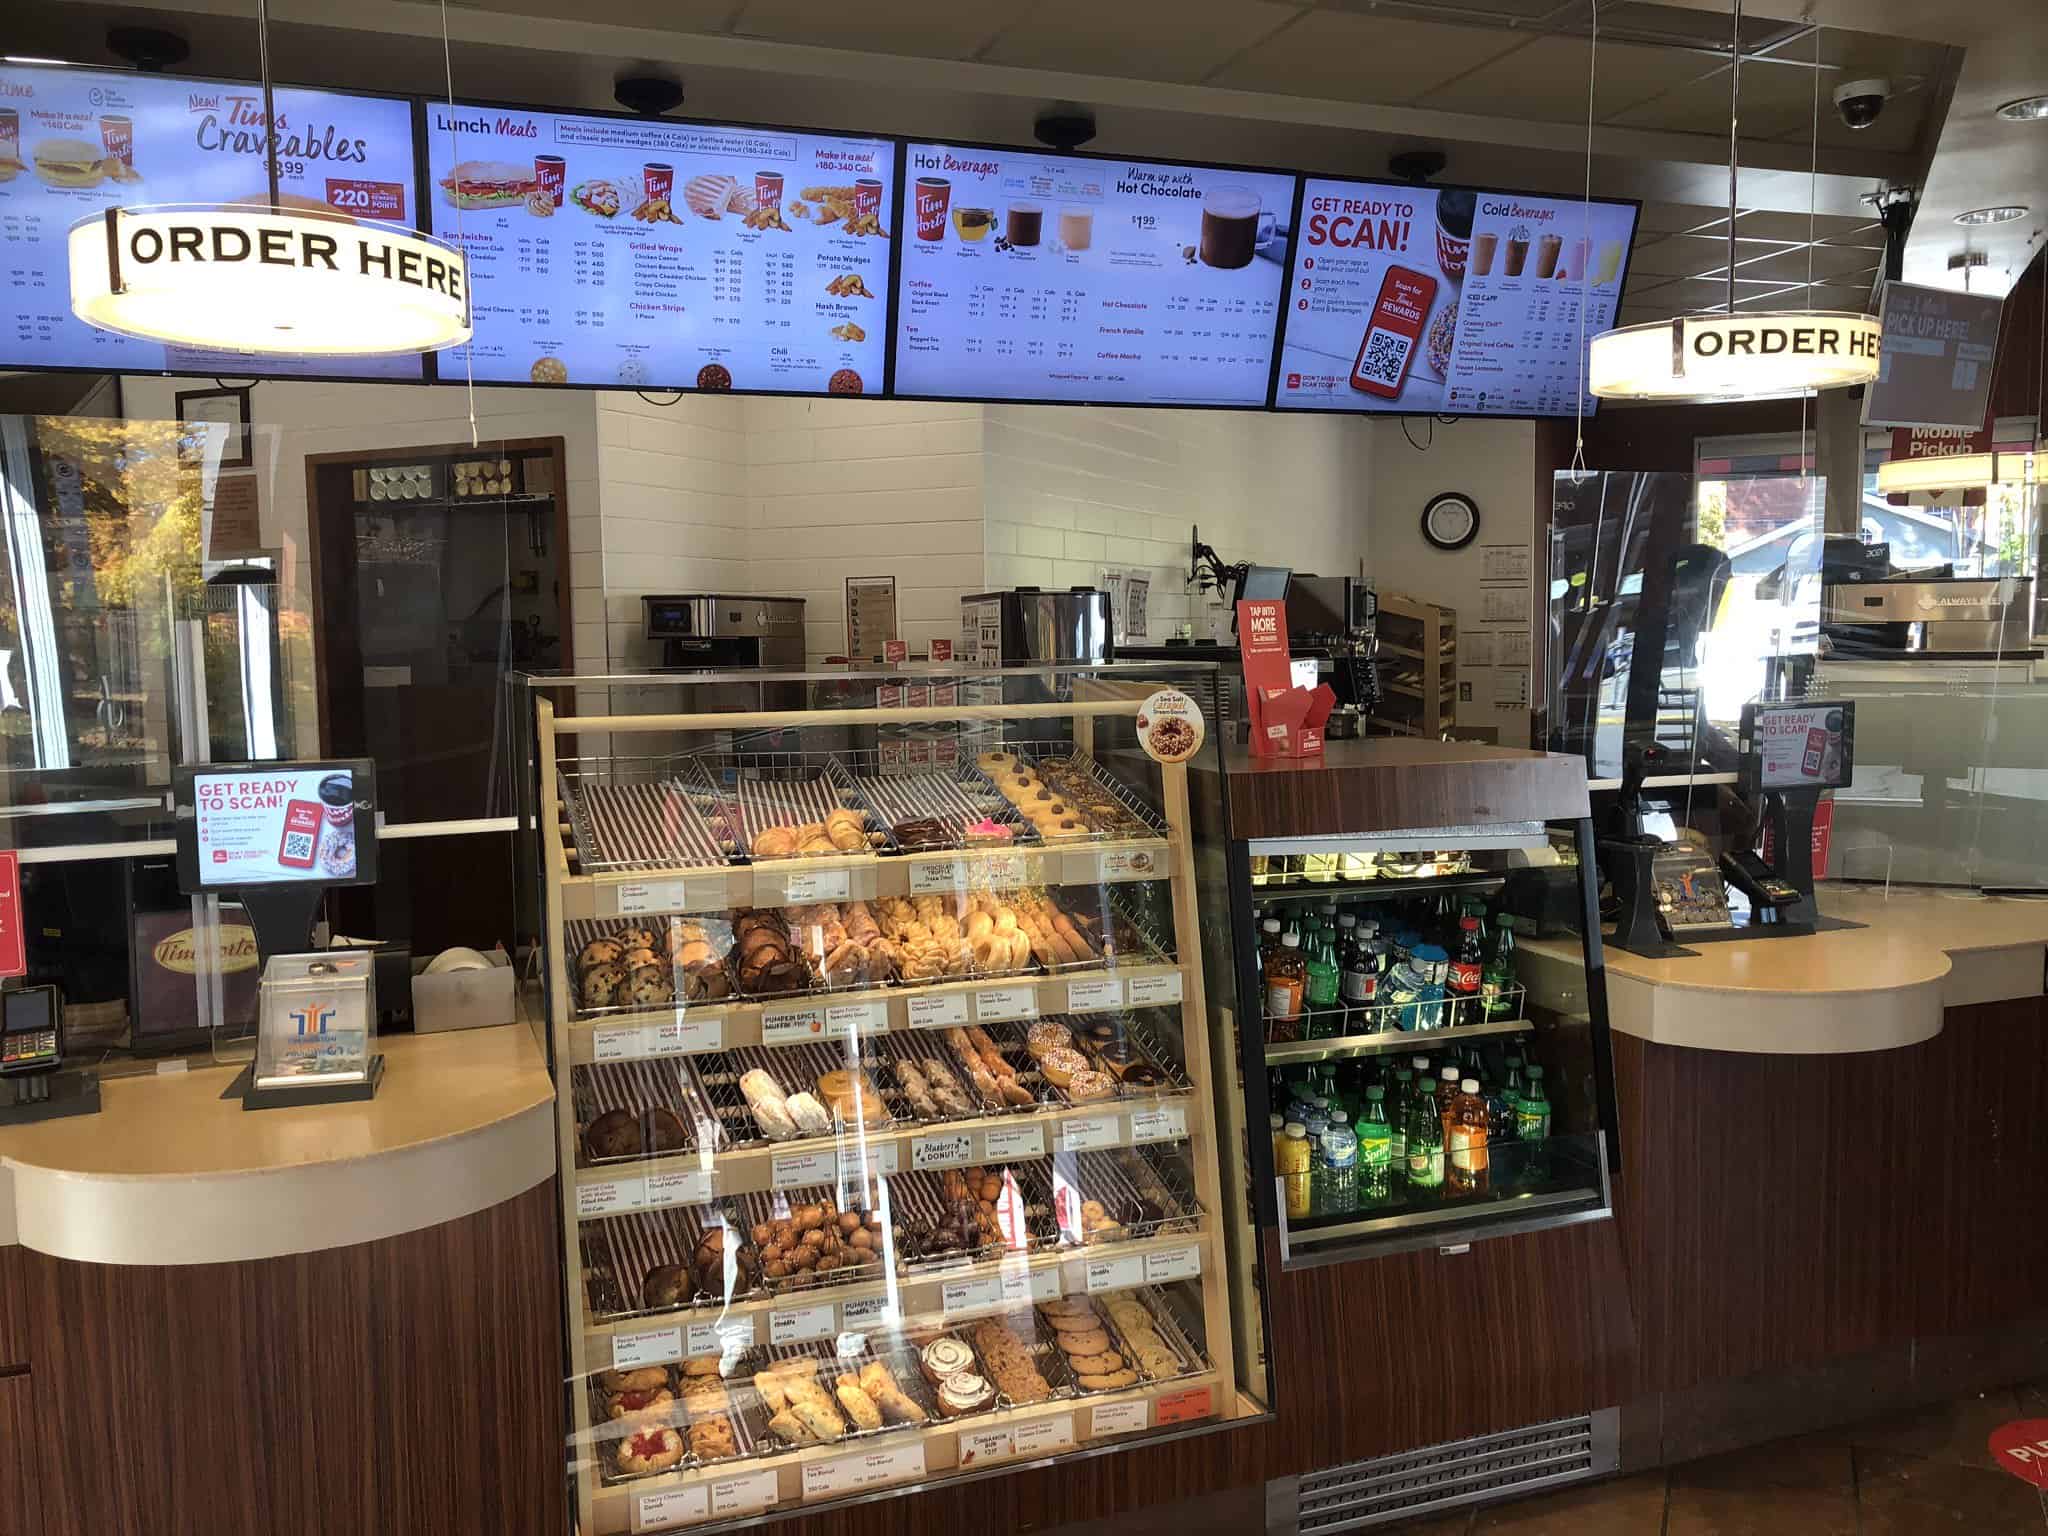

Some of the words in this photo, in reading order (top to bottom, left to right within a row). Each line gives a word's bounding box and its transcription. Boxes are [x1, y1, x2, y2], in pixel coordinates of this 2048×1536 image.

[189, 94, 220, 108] New!
[437, 115, 490, 136] Lunch
[495, 117, 537, 138] Meals
[584, 127, 608, 135] include
[611, 128, 639, 137] medium
[197, 115, 366, 162] Craveables
[816, 150, 838, 159] Make
[840, 151, 846, 159] it
[914, 153, 940, 170] Hot
[943, 154, 998, 180] Beverages
[1128, 167, 1156, 183] Warm
[1158, 173, 1169, 186] up
[333, 188, 368, 206] 220
[1117, 181, 1138, 195] Hot
[1141, 183, 1202, 199] Chocolate
[918, 194, 943, 213] Tim
[1312, 197, 1341, 212] GET
[1344, 200, 1391, 216] READY
[1394, 204, 1413, 217] TO
[1482, 202, 1509, 216] Cold
[1510, 201, 1555, 226] Beverages
[1308, 214, 1410, 252] SCAN!
[658, 245, 683, 253] Wraps
[130, 227, 340, 271] ORDER
[358, 240, 462, 301] HERE
[817, 254, 841, 263] Potato
[843, 255, 871, 265] Wedges
[1318, 257, 1334, 265] Open
[635, 281, 652, 289] Crispy
[909, 280, 932, 288] Coffee
[1394, 280, 1411, 293] Scan
[1412, 285, 1423, 296] for
[630, 302, 661, 311] Chicken
[663, 304, 685, 312] Strips
[816, 302, 833, 310] Hash
[836, 303, 857, 311] Brown
[1381, 301, 1421, 320] REWARDS
[1886, 311, 1915, 335] PICK
[1918, 316, 1934, 336] UP
[1694, 329, 1840, 356] ORDER
[1250, 606, 1261, 616] TAP
[1262, 606, 1275, 616] INTO
[1251, 617, 1276, 632] MORE
[1763, 714, 1783, 727] GET
[1785, 713, 1815, 725] READY
[1764, 725, 1777, 736] TO
[1779, 723, 1807, 736] SCAN!
[199, 782, 234, 797] GET
[239, 780, 298, 795] READY
[200, 797, 224, 811] TO
[230, 795, 284, 810] SCAN!
[159, 939, 195, 962] Tim
[765, 1014, 796, 1023] PUMPKIN
[797, 1011, 816, 1020] SPICE
[765, 1022, 791, 1030] MUFFIN
[1517, 1119, 1542, 1136] Sprite
[924, 1142, 960, 1154] Blueberry
[1364, 1144, 1390, 1163] Sprite
[928, 1151, 953, 1161] DONUT
[845, 1300, 875, 1310] PUMPKIN
[644, 1497, 662, 1505] Cherry
